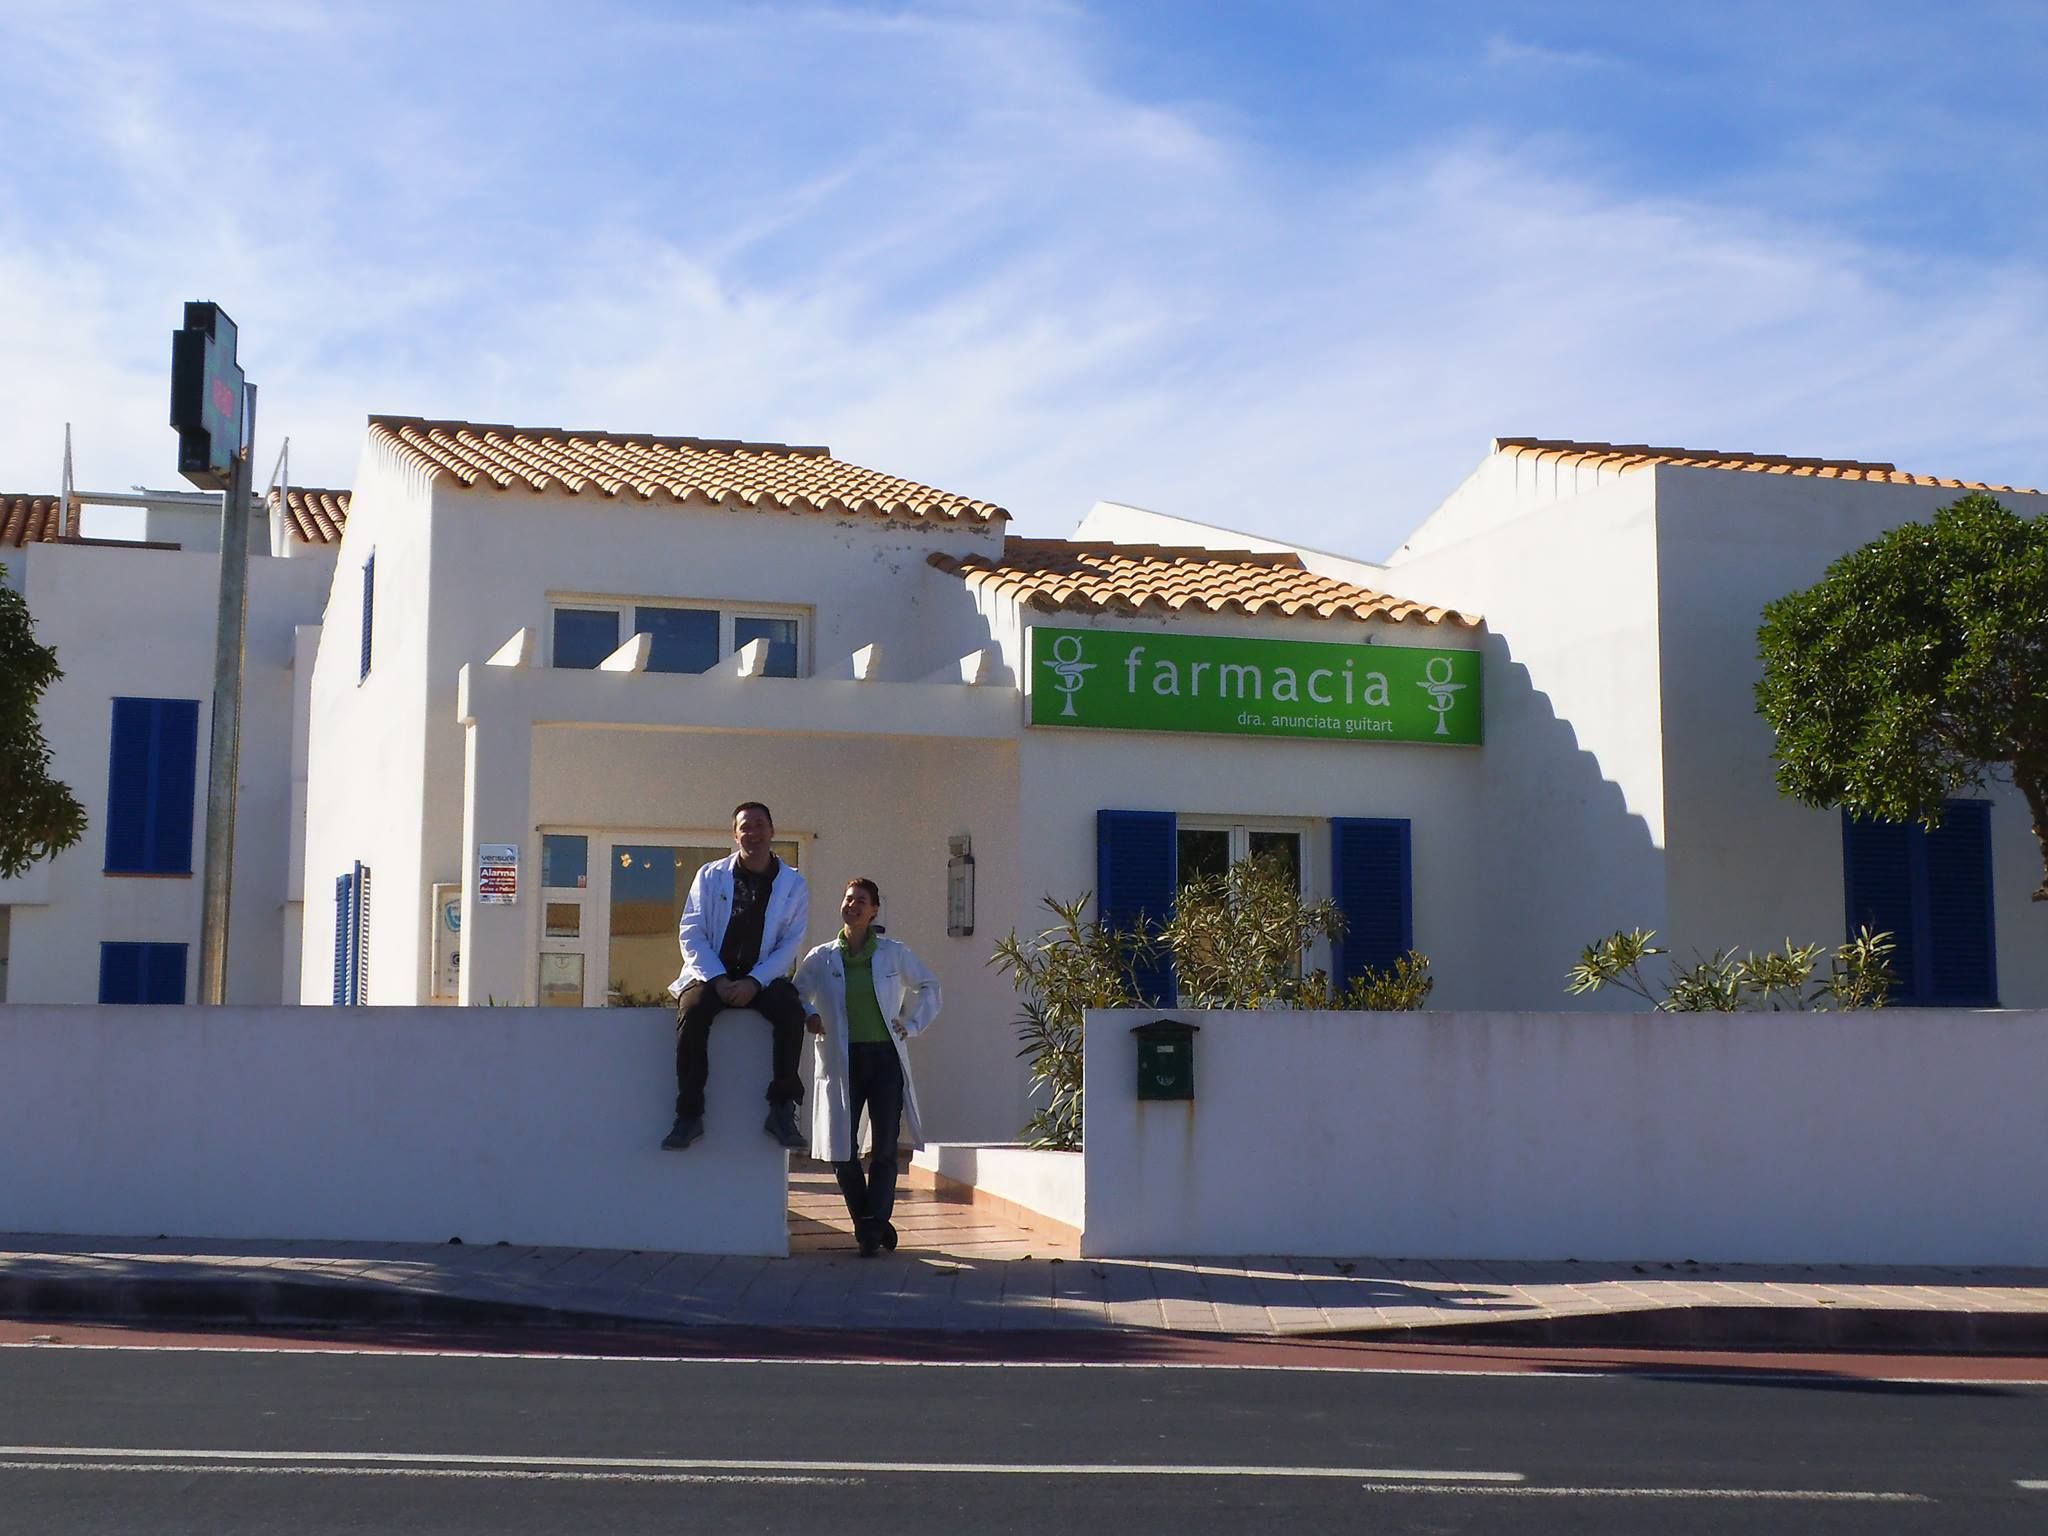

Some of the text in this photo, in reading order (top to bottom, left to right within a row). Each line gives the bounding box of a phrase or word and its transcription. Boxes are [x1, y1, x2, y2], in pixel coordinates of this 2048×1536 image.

[1124, 646, 1390, 706] farmacia
[1237, 712, 1393, 733] dra. anunciata guitart
[481, 868, 515, 877] Alarma
